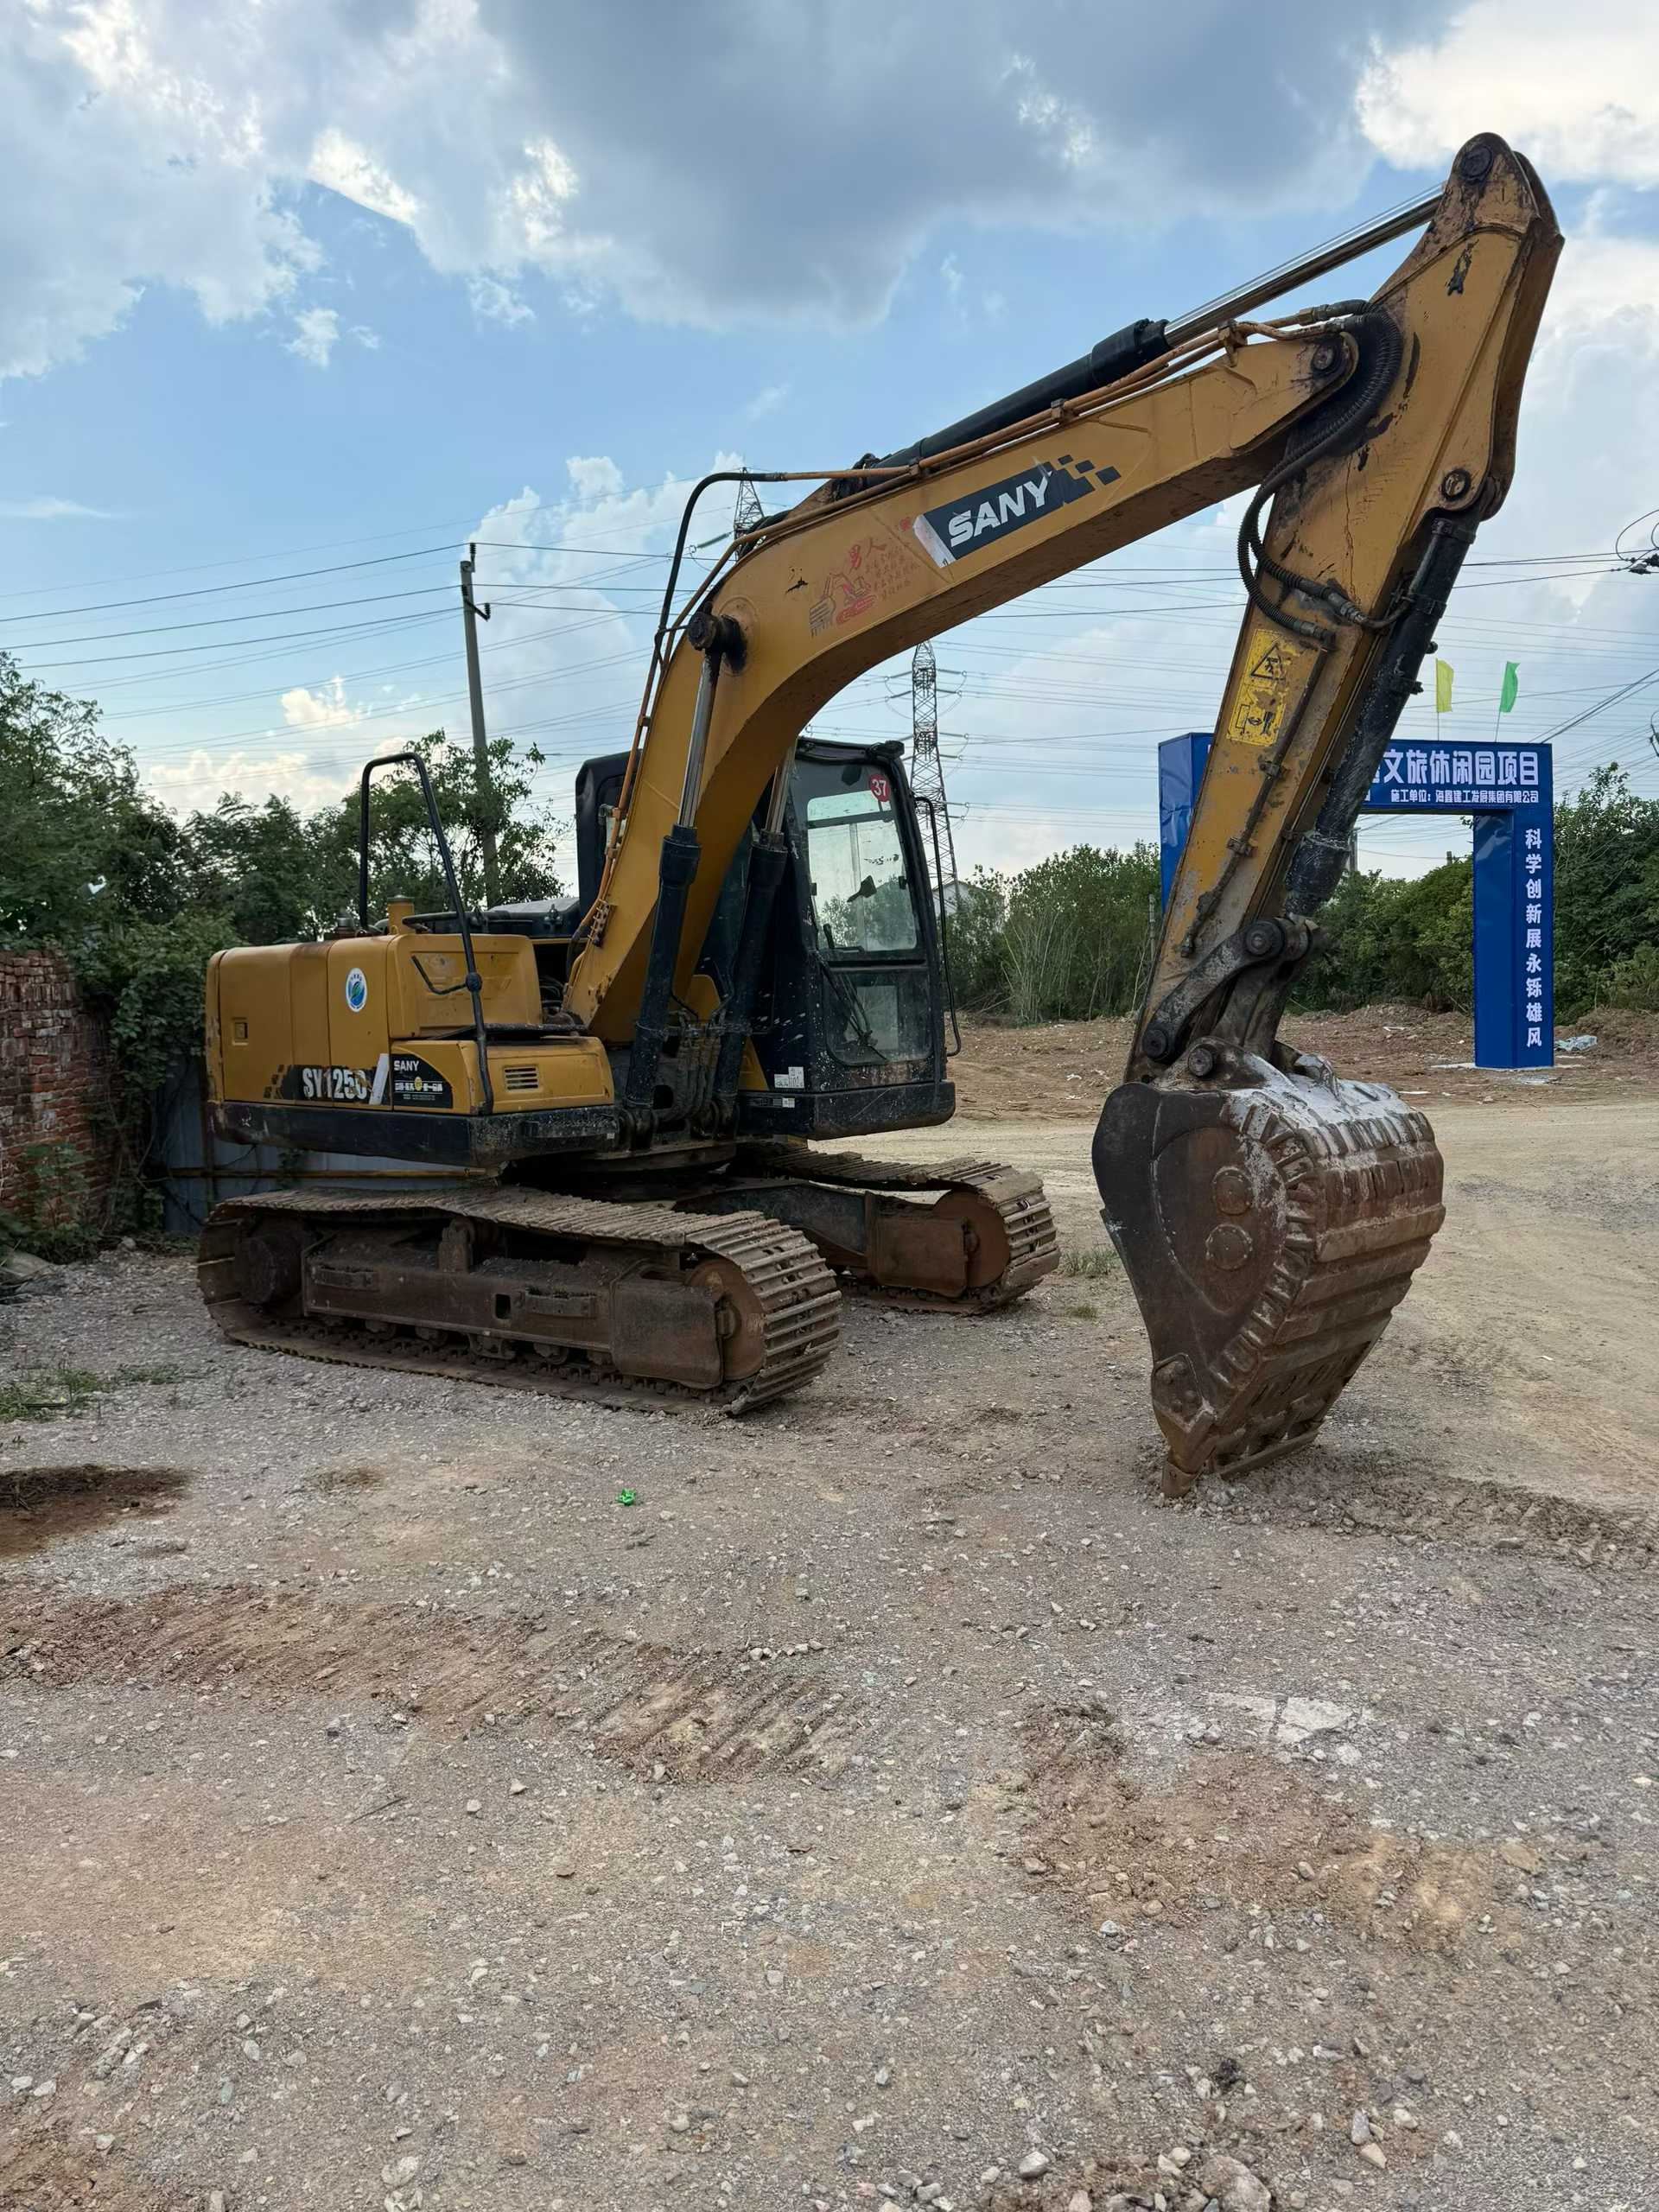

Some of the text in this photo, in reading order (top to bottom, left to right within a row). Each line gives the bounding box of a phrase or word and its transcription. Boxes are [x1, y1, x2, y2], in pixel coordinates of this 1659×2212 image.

[948, 471, 1052, 548] SANY
[1372, 748, 1539, 786] 文旅休闲园项目
[872, 779, 887, 797] 37
[1525, 829, 1542, 1047] 科学创新展永铄雄风
[393, 1060, 420, 1071] SANY
